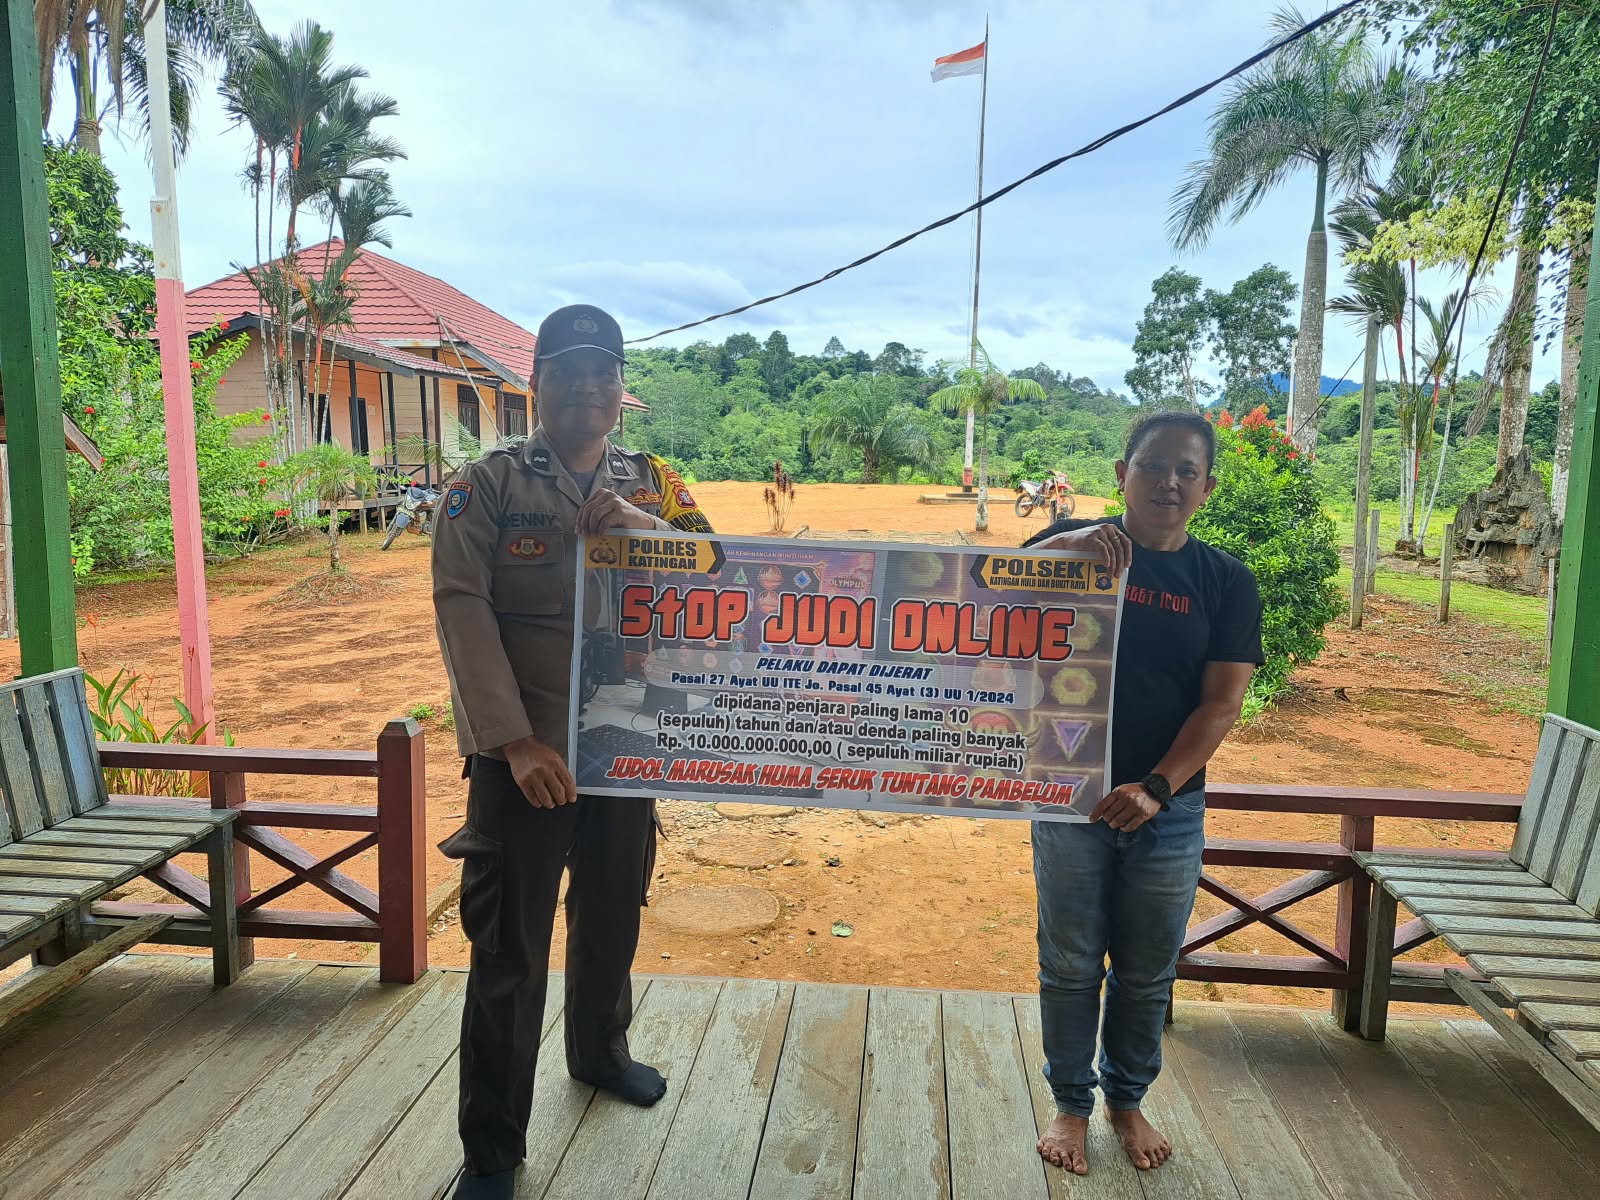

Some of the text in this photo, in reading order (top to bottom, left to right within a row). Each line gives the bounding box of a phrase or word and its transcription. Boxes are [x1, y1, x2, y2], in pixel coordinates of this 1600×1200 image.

[628, 538, 697, 557] POLRES
[628, 557, 697, 570] KATINGAN
[992, 558, 1084, 579] POLSEK
[989, 576, 1019, 587] KATINGAN
[762, 592, 877, 650] JUDI
[890, 599, 1077, 662] ONLINE
[756, 657, 933, 680] PELAKU DAPAT DIJERAT
[671, 672, 1014, 704] Pasal 27 Ayat UU ITE Jo. Pasal 45 Ayat (3) UU 1/2024
[714, 694, 969, 724] dipidana penjara paling lama 10
[657, 711, 1026, 750] (sepuluh) tahun dan/atau denda paling banyak
[657, 732, 682, 750] Rp.
[688, 734, 832, 757] 10.000.000.000,00
[847, 744, 909, 760] sepuluh
[914, 747, 961, 763] miliar
[965, 753, 1024, 772] rupiah)
[606, 756, 1076, 805] JUDOL MARUSAK HUMA SERUK TUNTANG PAMBELUM
